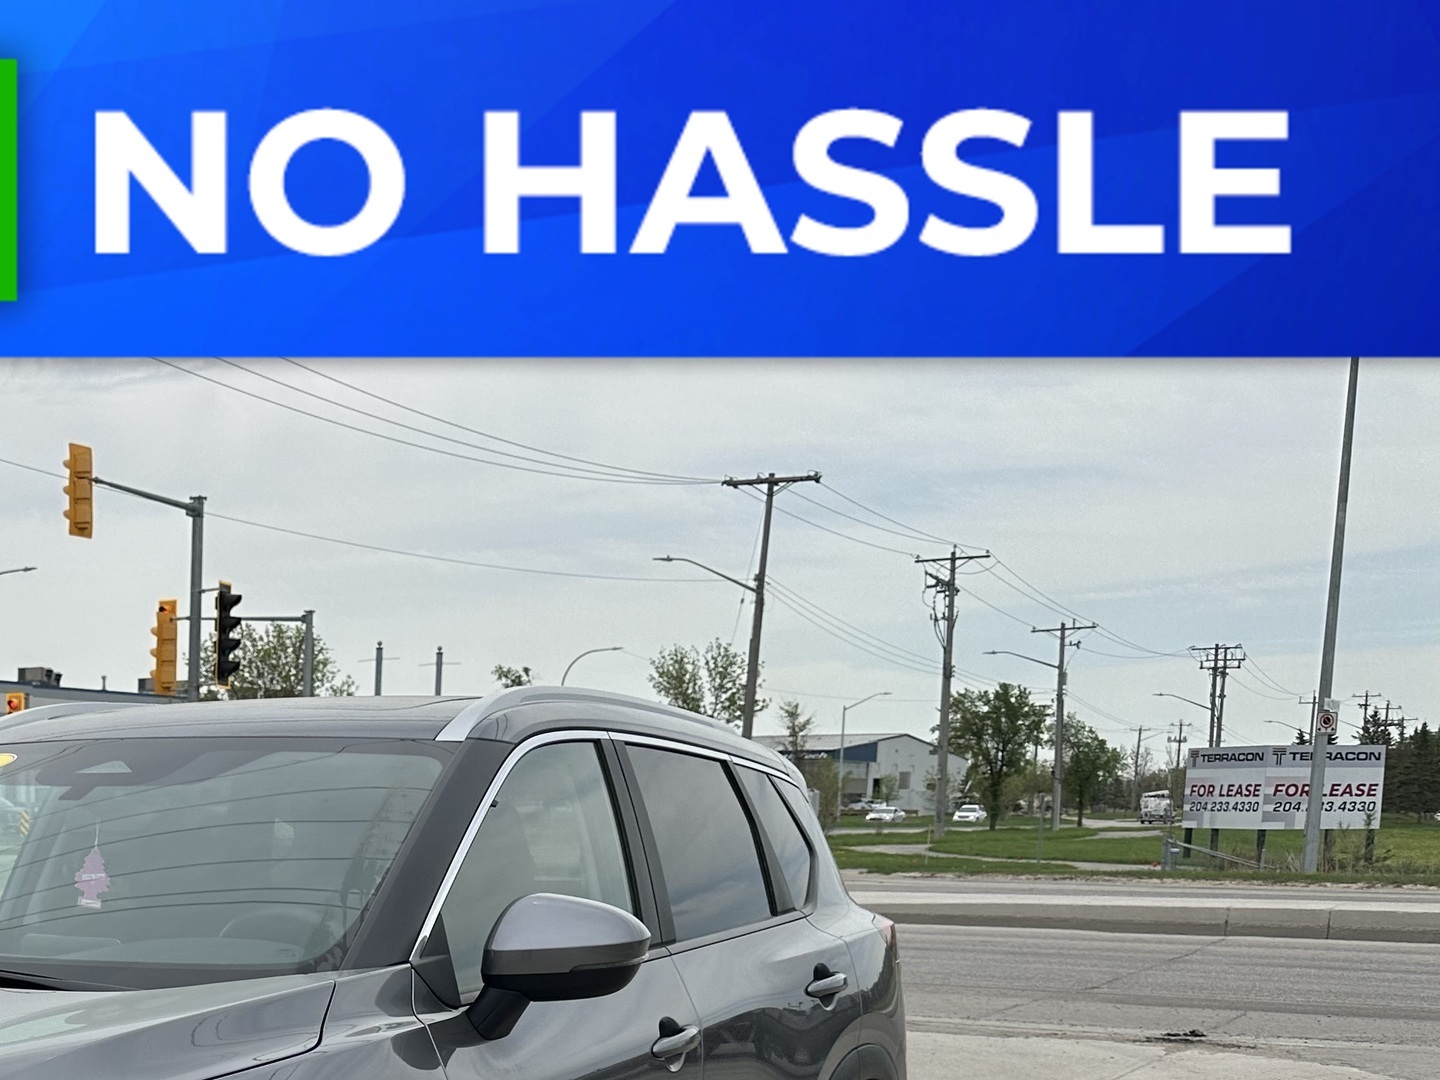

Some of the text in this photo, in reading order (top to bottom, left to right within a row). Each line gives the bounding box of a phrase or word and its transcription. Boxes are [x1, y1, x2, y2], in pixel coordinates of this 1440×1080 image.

[1201, 752, 1264, 763] TERRACON
[1289, 751, 1382, 761] TERACON
[1189, 784, 1262, 798] FOR LEASE
[1273, 784, 1379, 797] FOR EASE
[1189, 801, 1260, 812] 204.233.4330
[1273, 801, 1376, 812] 204.3.4330
